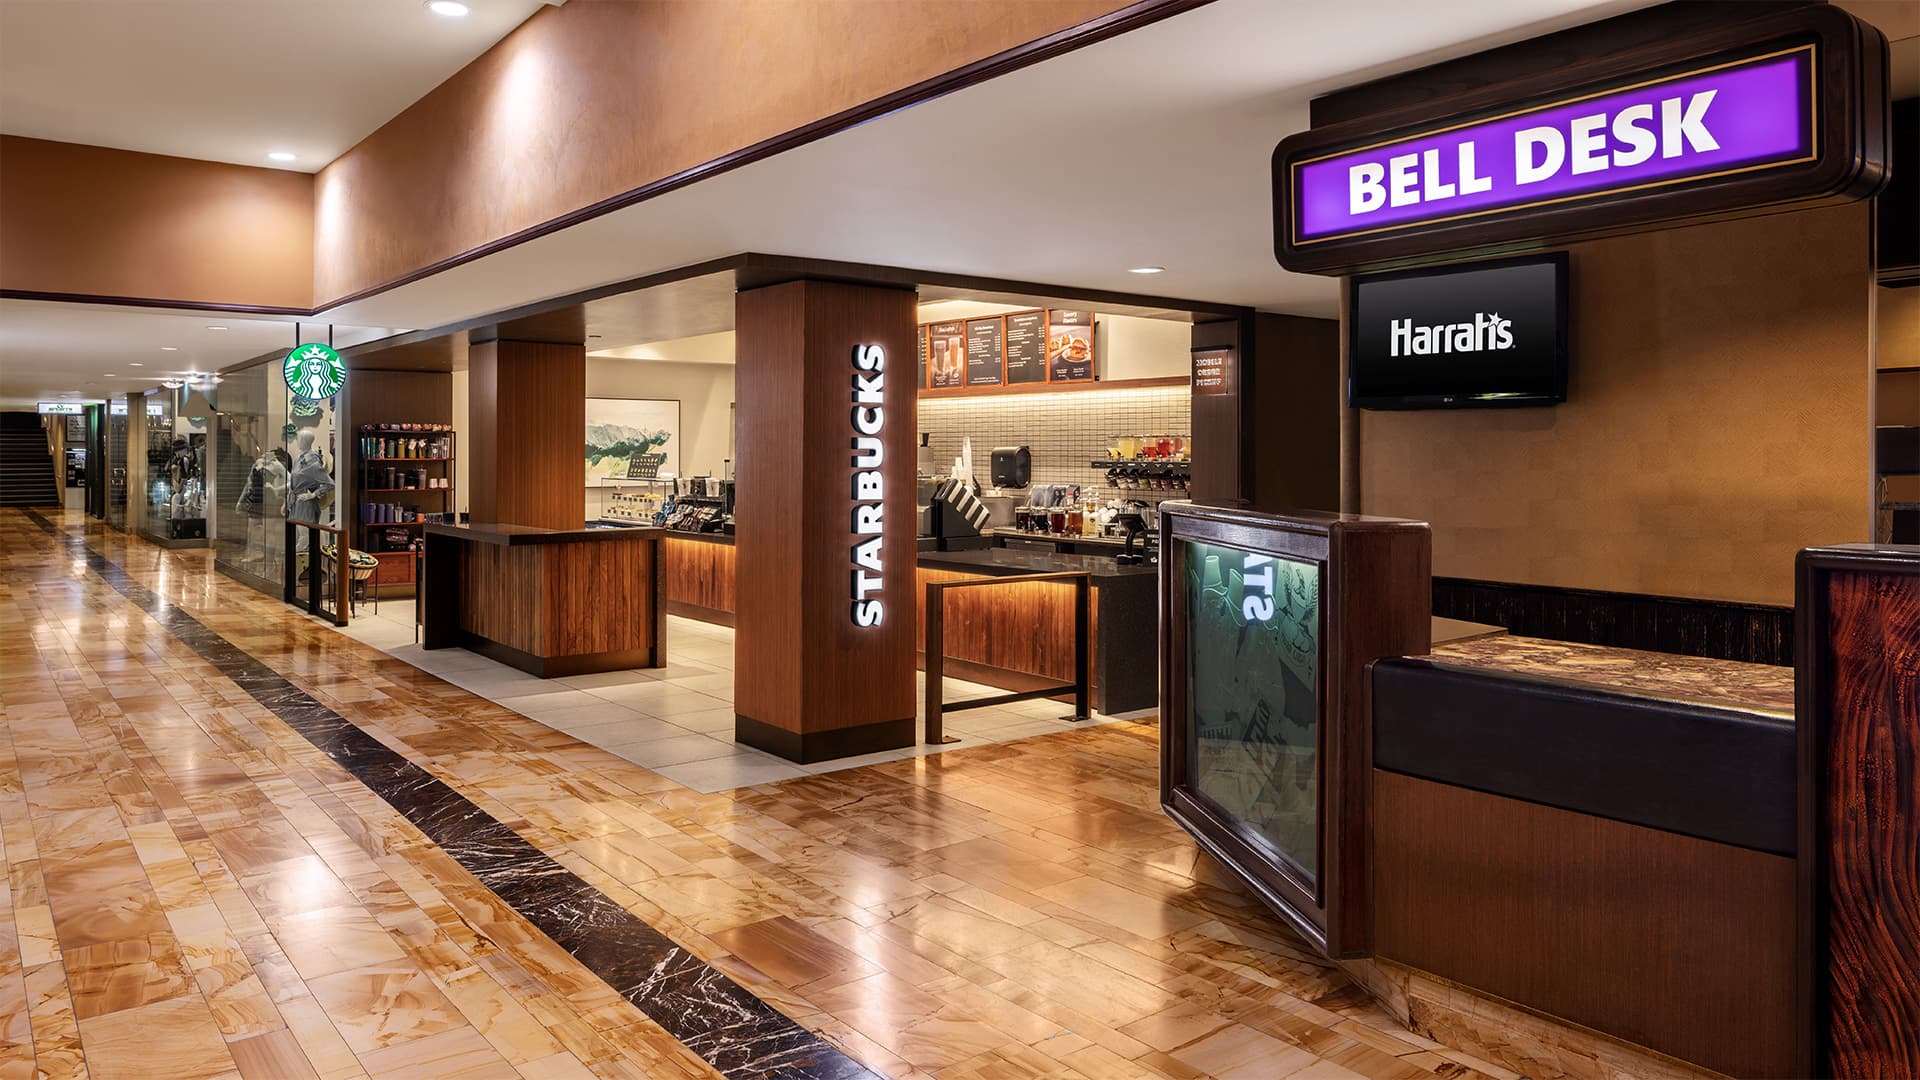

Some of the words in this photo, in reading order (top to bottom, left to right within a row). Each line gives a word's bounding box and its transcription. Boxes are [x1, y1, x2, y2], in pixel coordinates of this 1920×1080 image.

[1348, 139, 1493, 216] BELL
[1514, 88, 1721, 185] DESK
[853, 344, 885, 628] STARBUCKS
